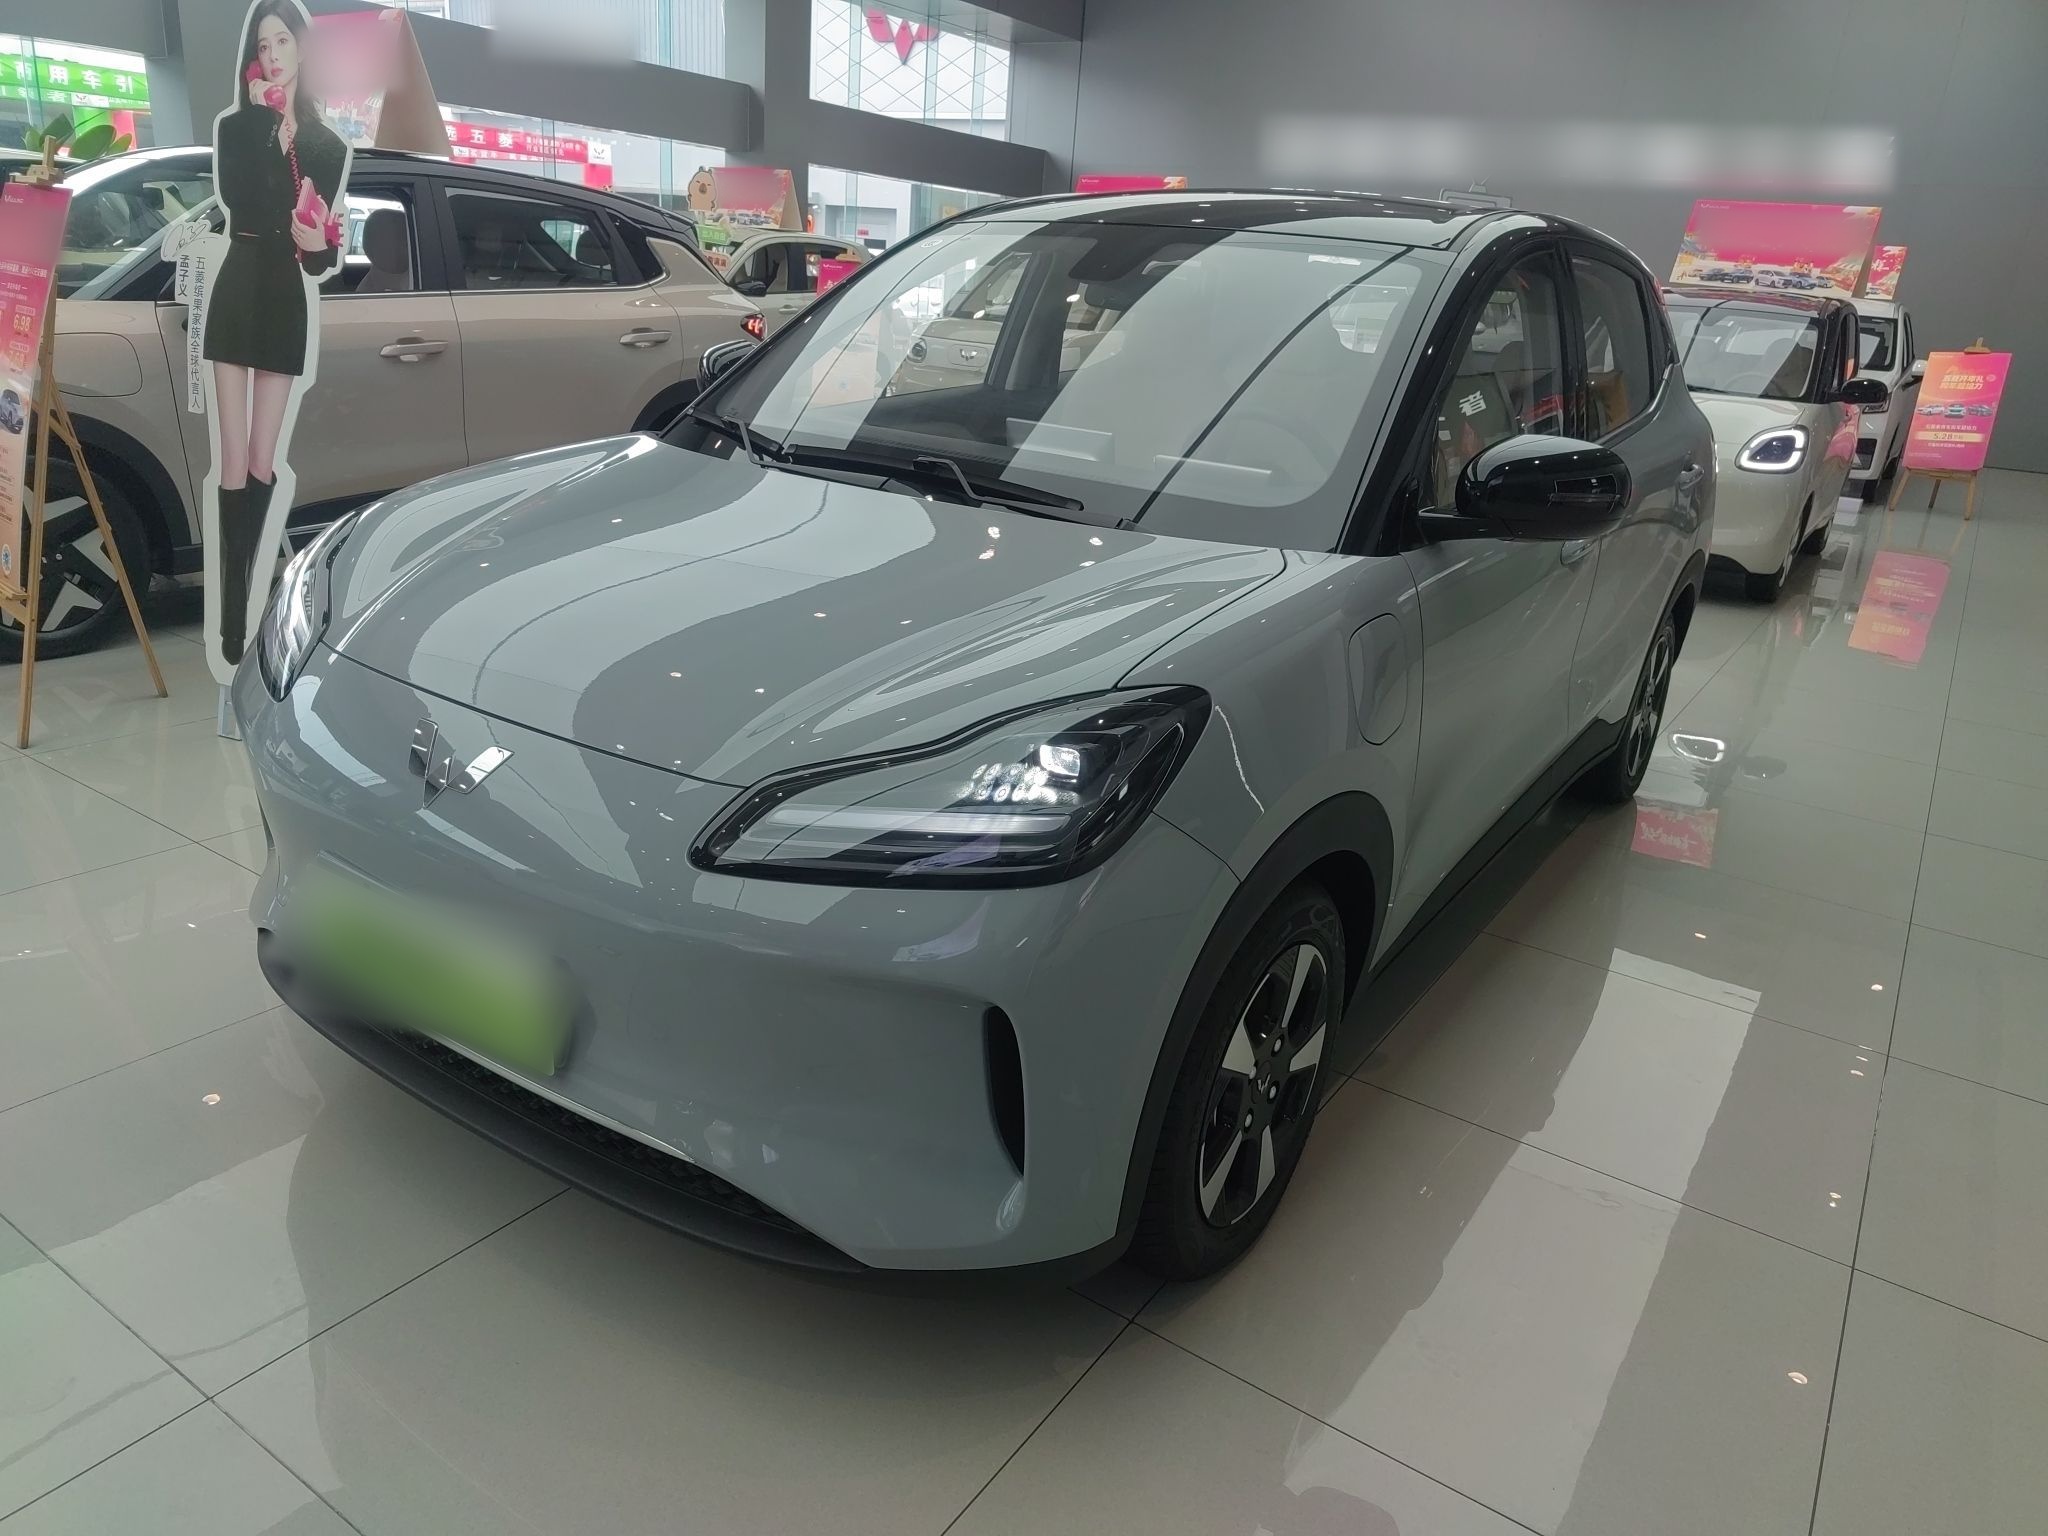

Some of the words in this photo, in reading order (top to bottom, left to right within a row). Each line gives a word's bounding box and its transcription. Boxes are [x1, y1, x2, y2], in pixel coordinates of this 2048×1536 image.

[0, 61, 134, 95] 商用车引
[178, 254, 190, 297] 孟子义
[1459, 390, 1487, 417] 者
